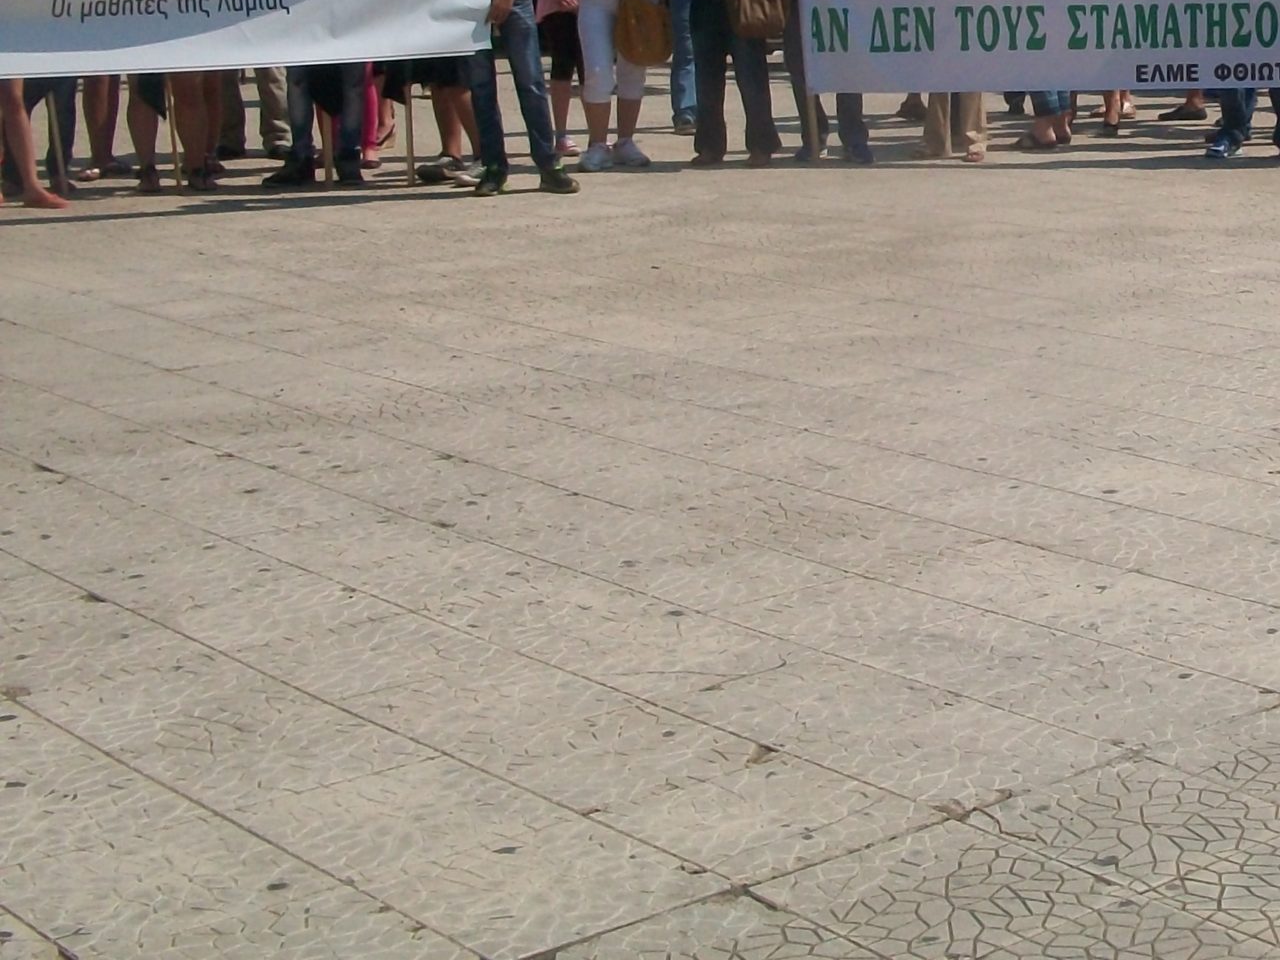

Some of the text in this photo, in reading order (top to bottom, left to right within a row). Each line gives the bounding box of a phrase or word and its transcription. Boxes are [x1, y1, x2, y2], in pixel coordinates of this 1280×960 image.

[810, 6, 849, 53] ΑΝ
[869, 6, 935, 53] ΔΕΝ
[955, 5, 1046, 51] ΤΟΥΣ
[1136, 64, 1198, 83] ΕΛΜΕ
